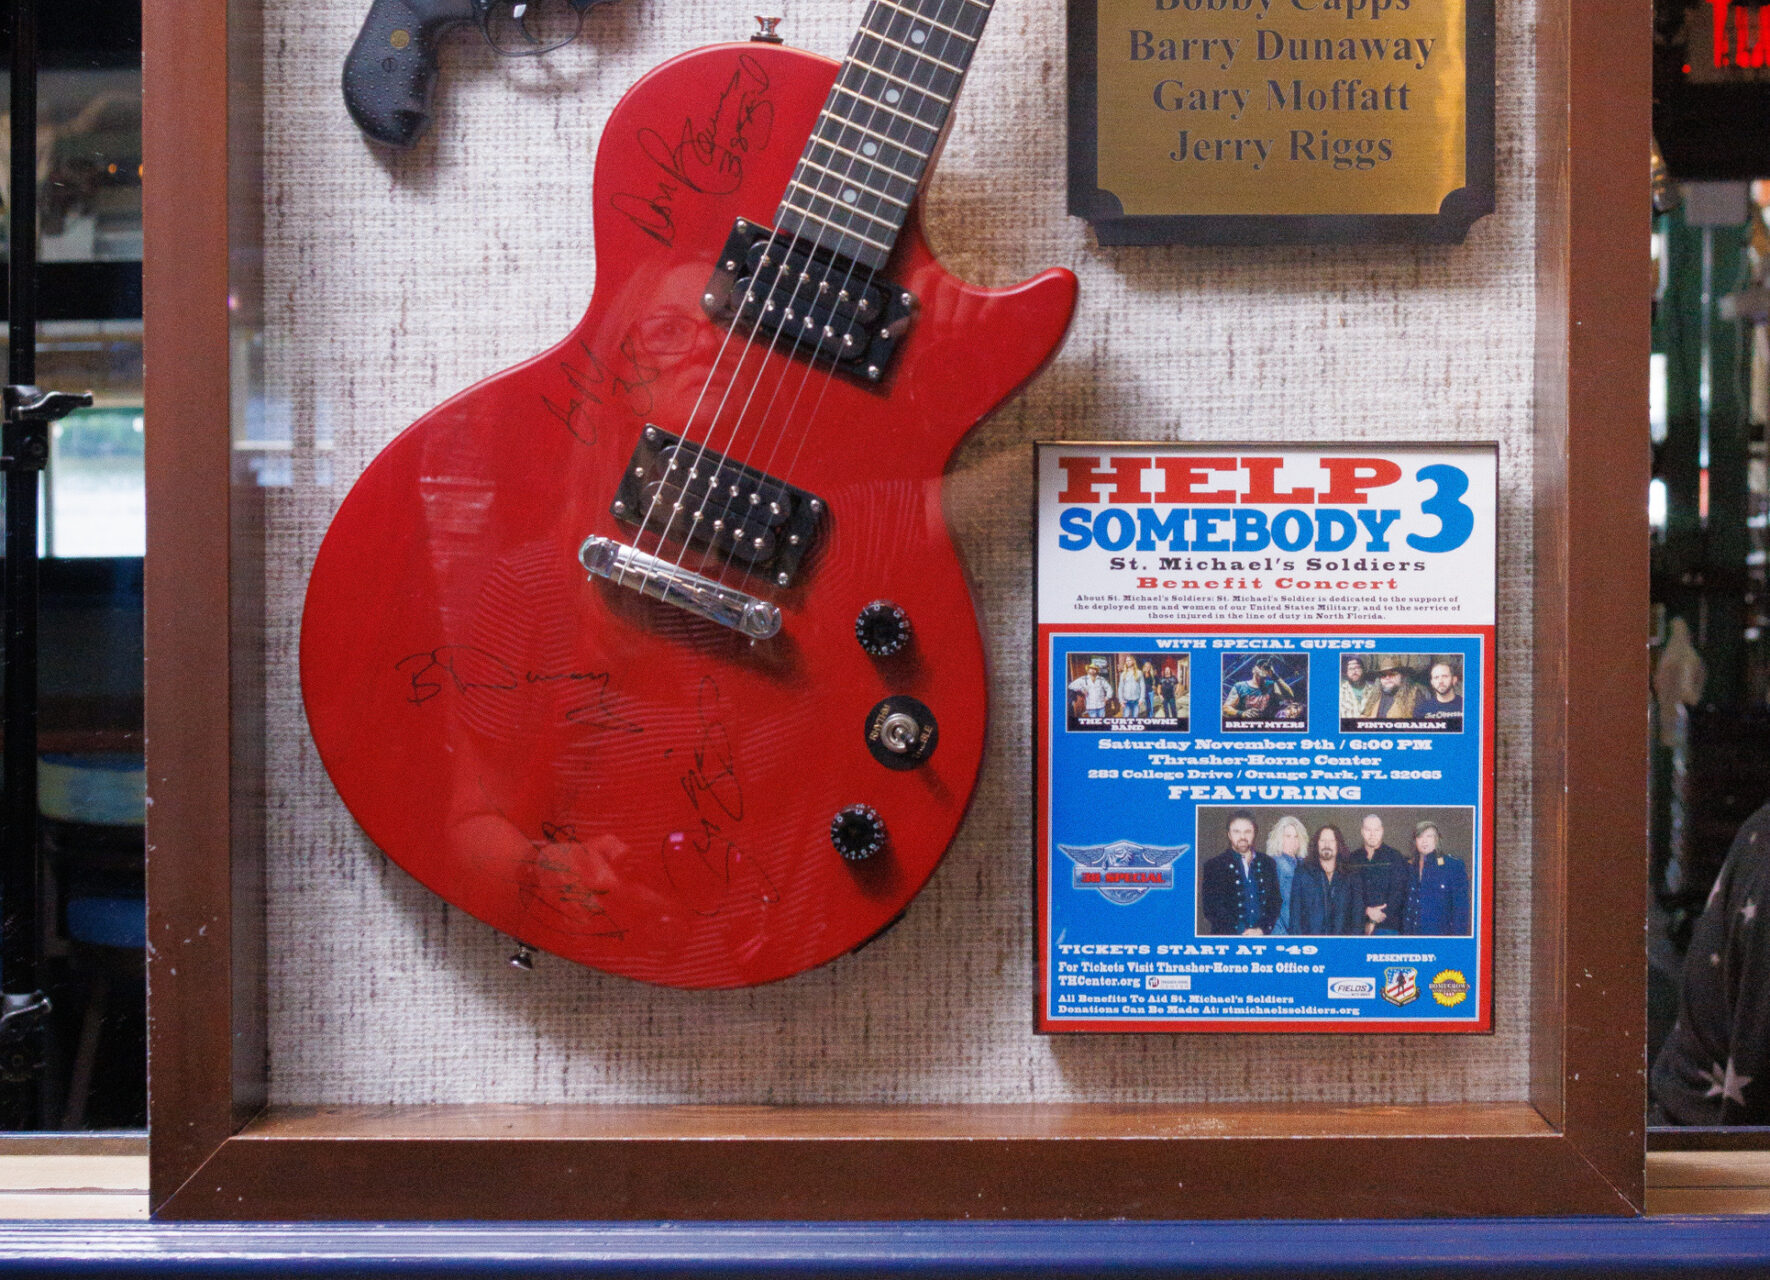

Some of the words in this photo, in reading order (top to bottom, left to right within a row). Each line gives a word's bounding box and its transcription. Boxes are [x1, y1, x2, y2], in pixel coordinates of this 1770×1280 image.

[1128, 29, 1241, 70] Barry
[1255, 29, 1436, 70] Dunaway
[1152, 79, 1250, 120] Gary
[1266, 78, 1411, 112] Moffatt
[1169, 130, 1275, 170] Jerry
[1289, 130, 1393, 170] Riggs
[1058, 456, 1402, 504] HELP
[1405, 463, 1475, 554] 3
[1058, 507, 1401, 553] SOMEBODY
[1109, 557, 1147, 571] St.
[1158, 557, 1295, 571] Michael's
[1306, 557, 1426, 572] Soldiers
[1136, 576, 1262, 589] Benefit
[1274, 577, 1397, 590] Concert
[1076, 594, 1105, 602] About
[1107, 594, 1120, 602] St.
[1123, 594, 1169, 602] Michael's
[1171, 594, 1215, 602] Soldiers:
[1216, 594, 1230, 602] St.
[1232, 594, 1279, 602] Michael's
[1281, 595, 1315, 603] Soldier
[1318, 595, 1327, 603] is
[1329, 595, 1376, 603] dedicated
[1378, 595, 1389, 603] to
[1390, 595, 1406, 603] the
[1409, 596, 1447, 604] support
[1449, 595, 1458, 603] of
[1073, 603, 1090, 611] the
[1092, 603, 1135, 612] deployed
[1161, 603, 1179, 611] and
[1218, 603, 1228, 611] of
[1249, 603, 1282, 611] United
[1284, 603, 1315, 611] States
[1317, 603, 1360, 612] Military,
[1363, 604, 1381, 612] and
[1383, 604, 1393, 612] to
[1395, 604, 1411, 612] the
[1414, 604, 1449, 612] service
[1451, 604, 1461, 612] of
[1176, 612, 1213, 620] injured
[1227, 612, 1244, 620] the
[1245, 612, 1265, 620] line
[1267, 612, 1277, 620] of
[1278, 612, 1301, 621] duty
[1315, 612, 1345, 620] North
[1346, 612, 1386, 620] Florida.
[1155, 638, 1207, 649] WITH
[1212, 639, 1296, 649] SPECIAL
[1299, 639, 1376, 649] GUESTS
[1078, 717, 1103, 725] THE
[1103, 717, 1138, 725] CURT
[1138, 717, 1178, 725] TOWNE
[1225, 721, 1263, 729] BRETT
[1264, 721, 1305, 729] MYERS
[1356, 721, 1394, 729] PINTO
[1394, 721, 1447, 729] GRAHAM
[1111, 724, 1146, 732] BAND
[1098, 738, 1192, 752] Saturday
[1194, 738, 1297, 750] November
[1300, 738, 1336, 750] 9th
[1349, 738, 1394, 751] 6:00
[1396, 739, 1433, 751] PM
[1148, 754, 1311, 766] Thrasher-Horne
[1314, 754, 1382, 766] Center
[1121, 769, 1185, 781] College
[1187, 769, 1234, 779] Drive
[1244, 769, 1308, 781] Orange
[1310, 769, 1359, 781] Park,
[1361, 769, 1388, 780] FL
[1390, 769, 1443, 780] 32065
[1168, 785, 1362, 801] FEATURING
[1080, 872, 1101, 883] 38
[1105, 872, 1166, 883] SPECIAL
[1058, 944, 1151, 955] TICKETS
[1156, 944, 1230, 956] START
[1235, 944, 1267, 956] AT
[1366, 953, 1421, 962] PRESENTED
[1058, 961, 1079, 973] For
[1080, 961, 1125, 973] Tickets
[1126, 961, 1155, 973] Visit
[1156, 961, 1249, 973] Thrasher-Horne
[1250, 961, 1274, 974] Box
[1275, 961, 1310, 974] Office
[1311, 964, 1326, 974] or
[1057, 974, 1141, 989] THCenter.org
[1337, 984, 1367, 992] FIELDS
[1058, 994, 1076, 1003] All
[1078, 994, 1128, 1003] Benefits
[1129, 994, 1146, 1003] To
[1147, 994, 1168, 1004] Aid
[1170, 994, 1186, 1003] St.
[1188, 994, 1244, 1004] Michael's
[1245, 994, 1295, 1004] Soldiers
[1058, 1004, 1120, 1014] Donations
[1121, 1005, 1146, 1014] Can
[1147, 1005, 1165, 1014] Be
[1166, 1005, 1200, 1014] Made
[1202, 1005, 1220, 1014] At:
[1222, 1005, 1361, 1016] stmichaelssoldiers.org
